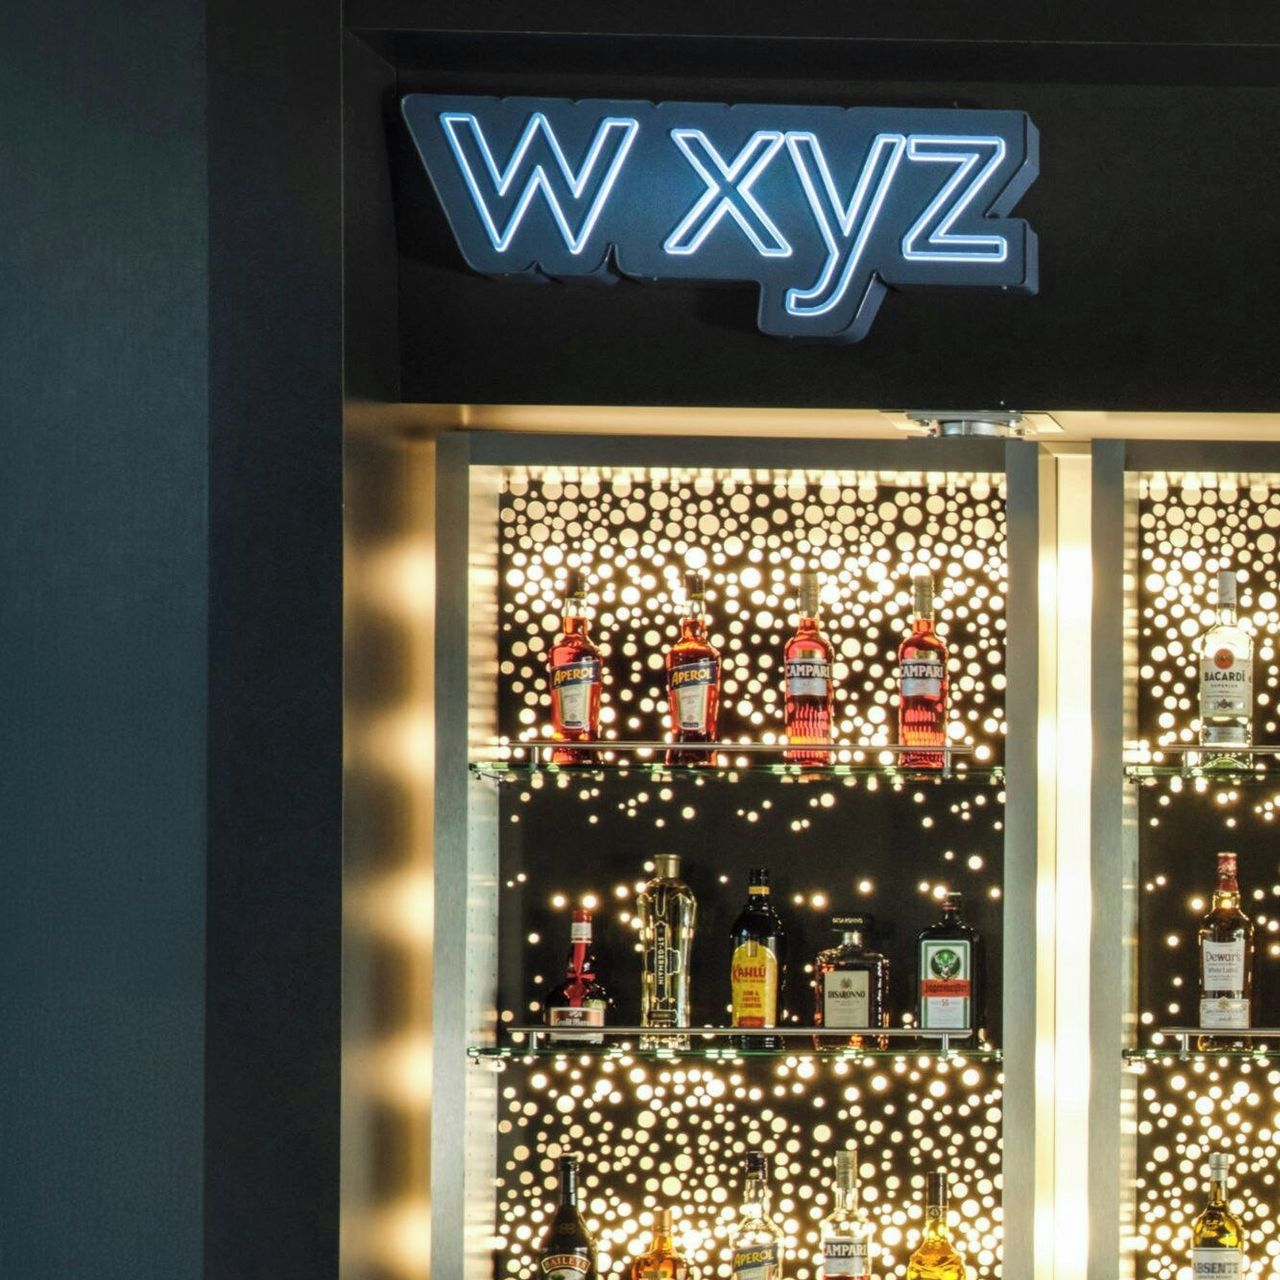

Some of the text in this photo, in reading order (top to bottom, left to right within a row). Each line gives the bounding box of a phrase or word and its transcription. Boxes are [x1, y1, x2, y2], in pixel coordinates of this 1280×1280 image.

[554, 667, 594, 684] APEROL
[672, 668, 712, 685] APEROL
[1206, 951, 1240, 963] Dewar's
[827, 990, 866, 999] DISARONNO
[543, 1256, 588, 1271] BAILEYS
[734, 1249, 774, 1266] APEROL
